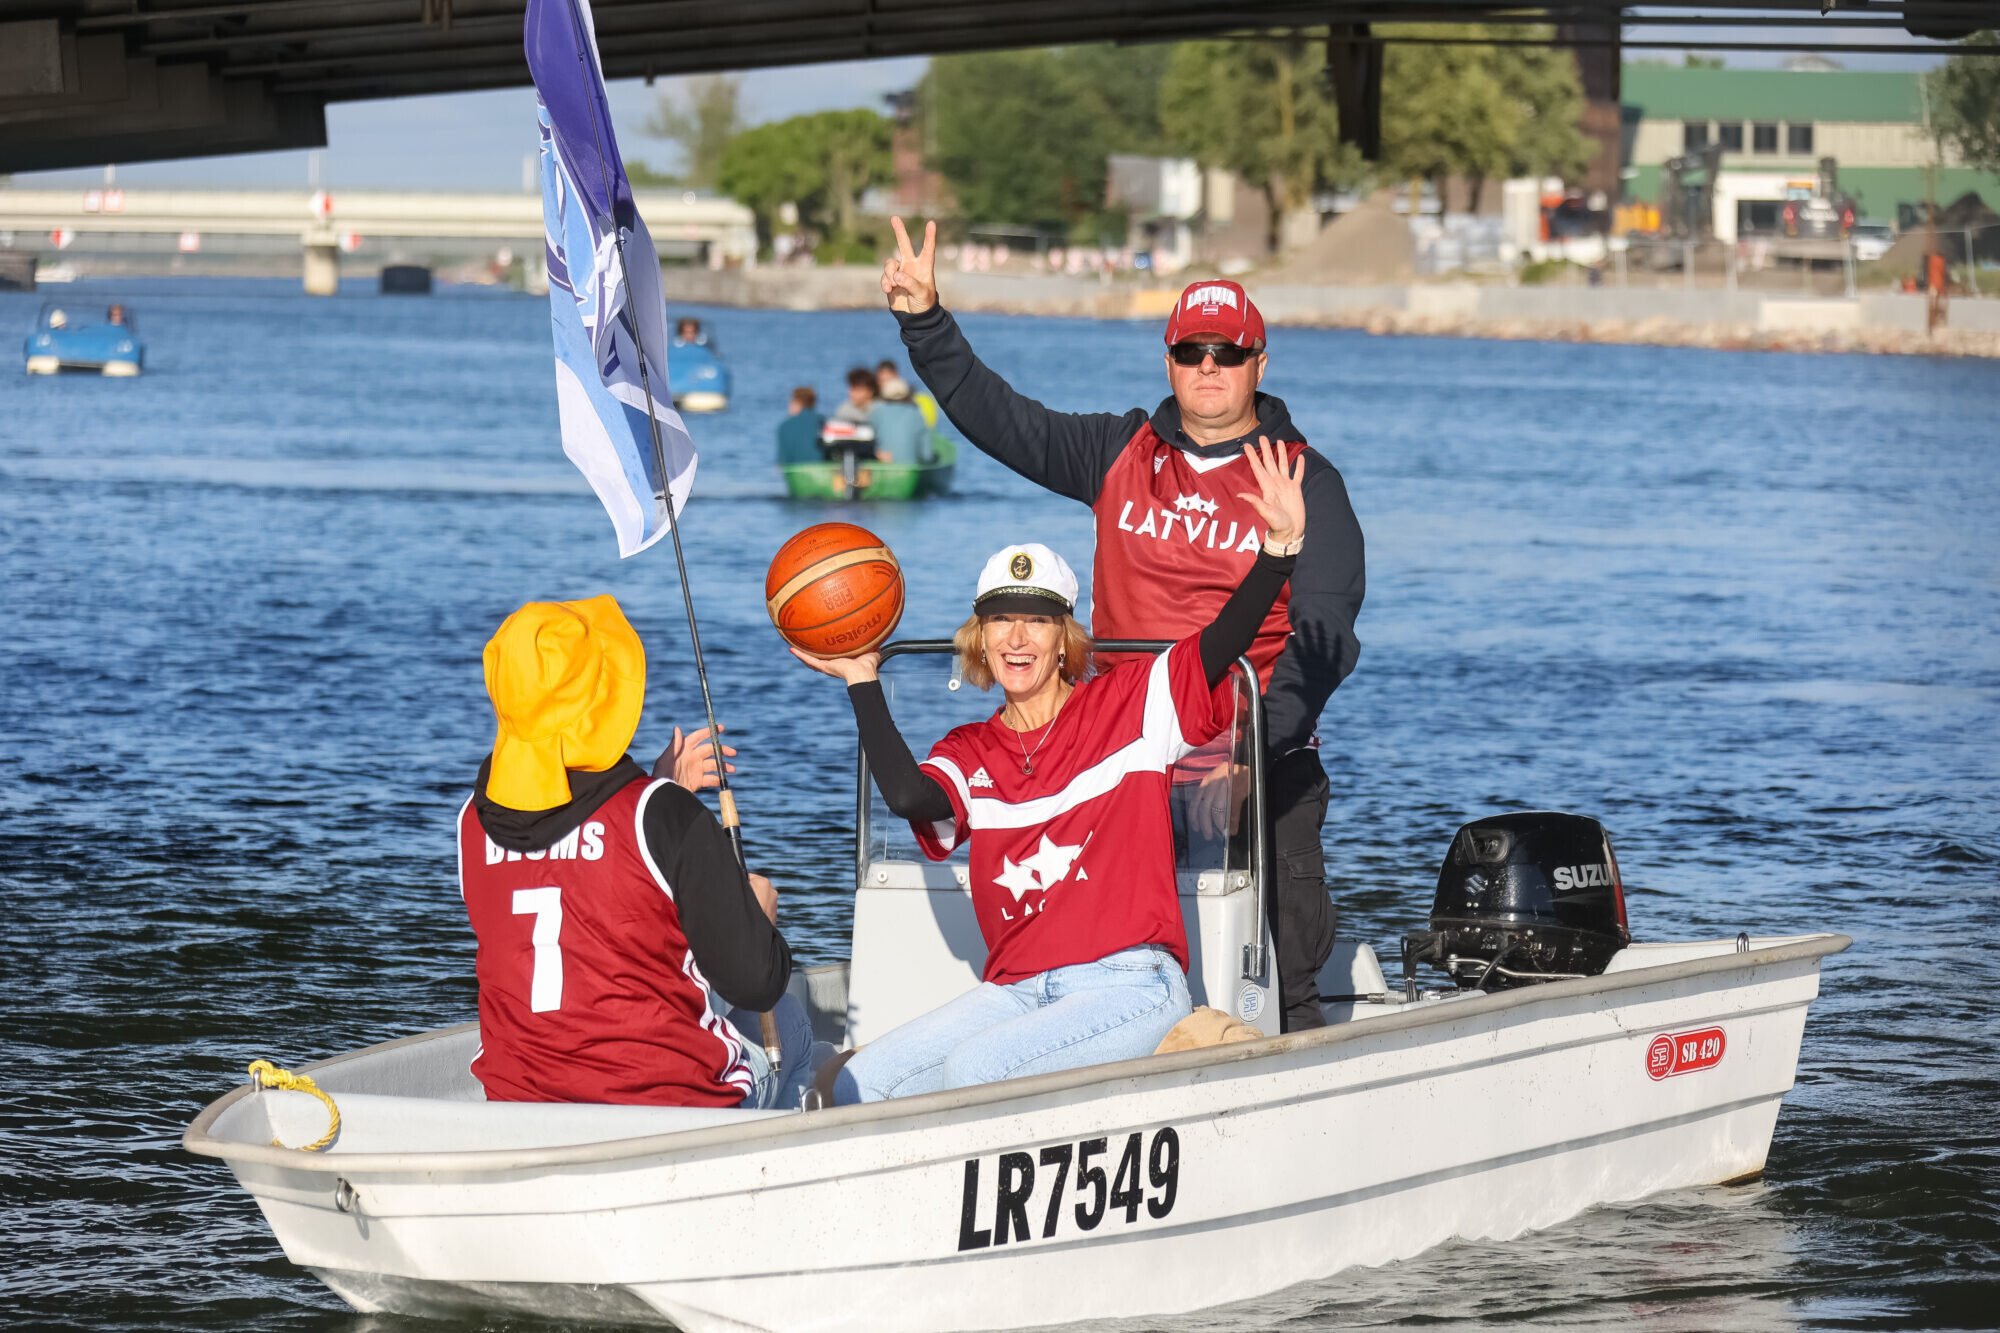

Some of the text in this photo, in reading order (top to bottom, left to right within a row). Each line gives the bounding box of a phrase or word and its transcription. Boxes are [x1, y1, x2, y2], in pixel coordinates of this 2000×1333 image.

[1186, 286, 1238, 311] LATVIA
[1118, 500, 1261, 556] LATVIJA
[824, 613, 882, 646] molten
[485, 821, 606, 866] BMS
[512, 886, 564, 1014] 7
[1681, 1036, 1721, 1064] SB 420
[958, 1126, 1180, 1252] LR7549
